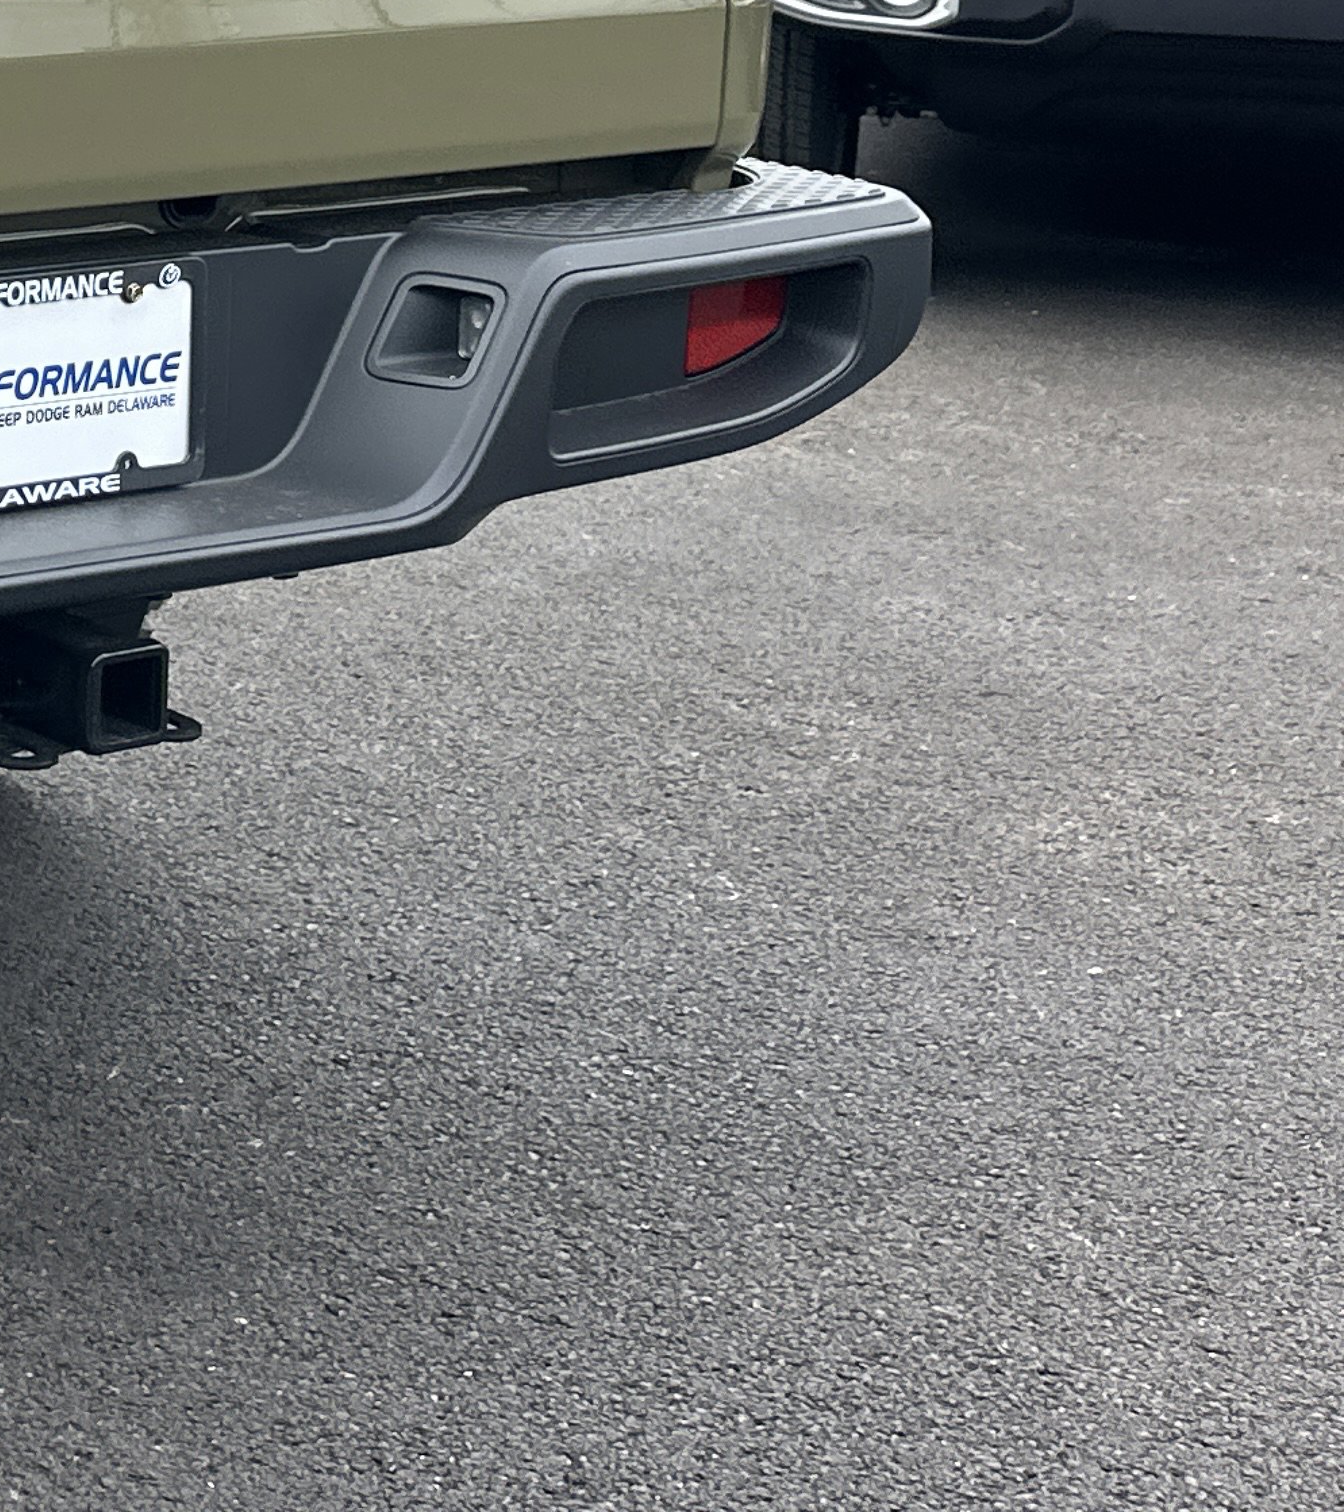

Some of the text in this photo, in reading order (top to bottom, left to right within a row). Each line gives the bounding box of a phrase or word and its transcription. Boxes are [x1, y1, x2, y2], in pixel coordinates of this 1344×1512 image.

[26, 405, 70, 425] DODGE
[74, 400, 103, 419] RAM
[107, 392, 176, 414] DELAWARE
